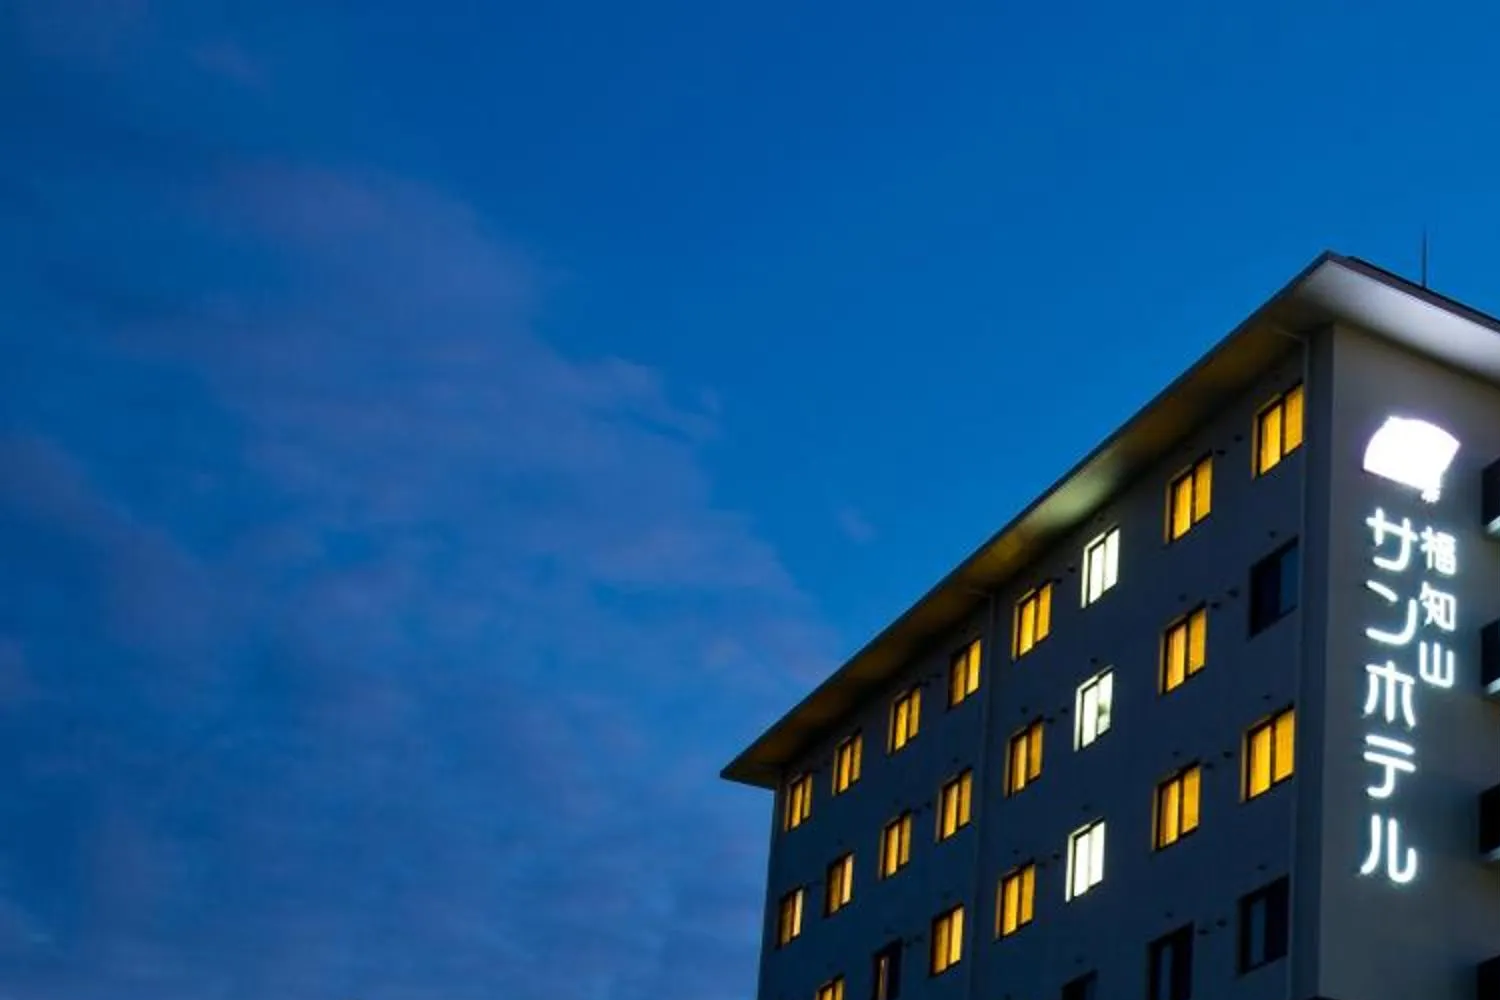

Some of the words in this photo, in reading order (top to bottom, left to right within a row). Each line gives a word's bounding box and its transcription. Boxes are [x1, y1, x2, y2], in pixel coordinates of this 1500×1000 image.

[1360, 506, 1419, 885] サンホテル
[1418, 525, 1458, 689] 福知山
